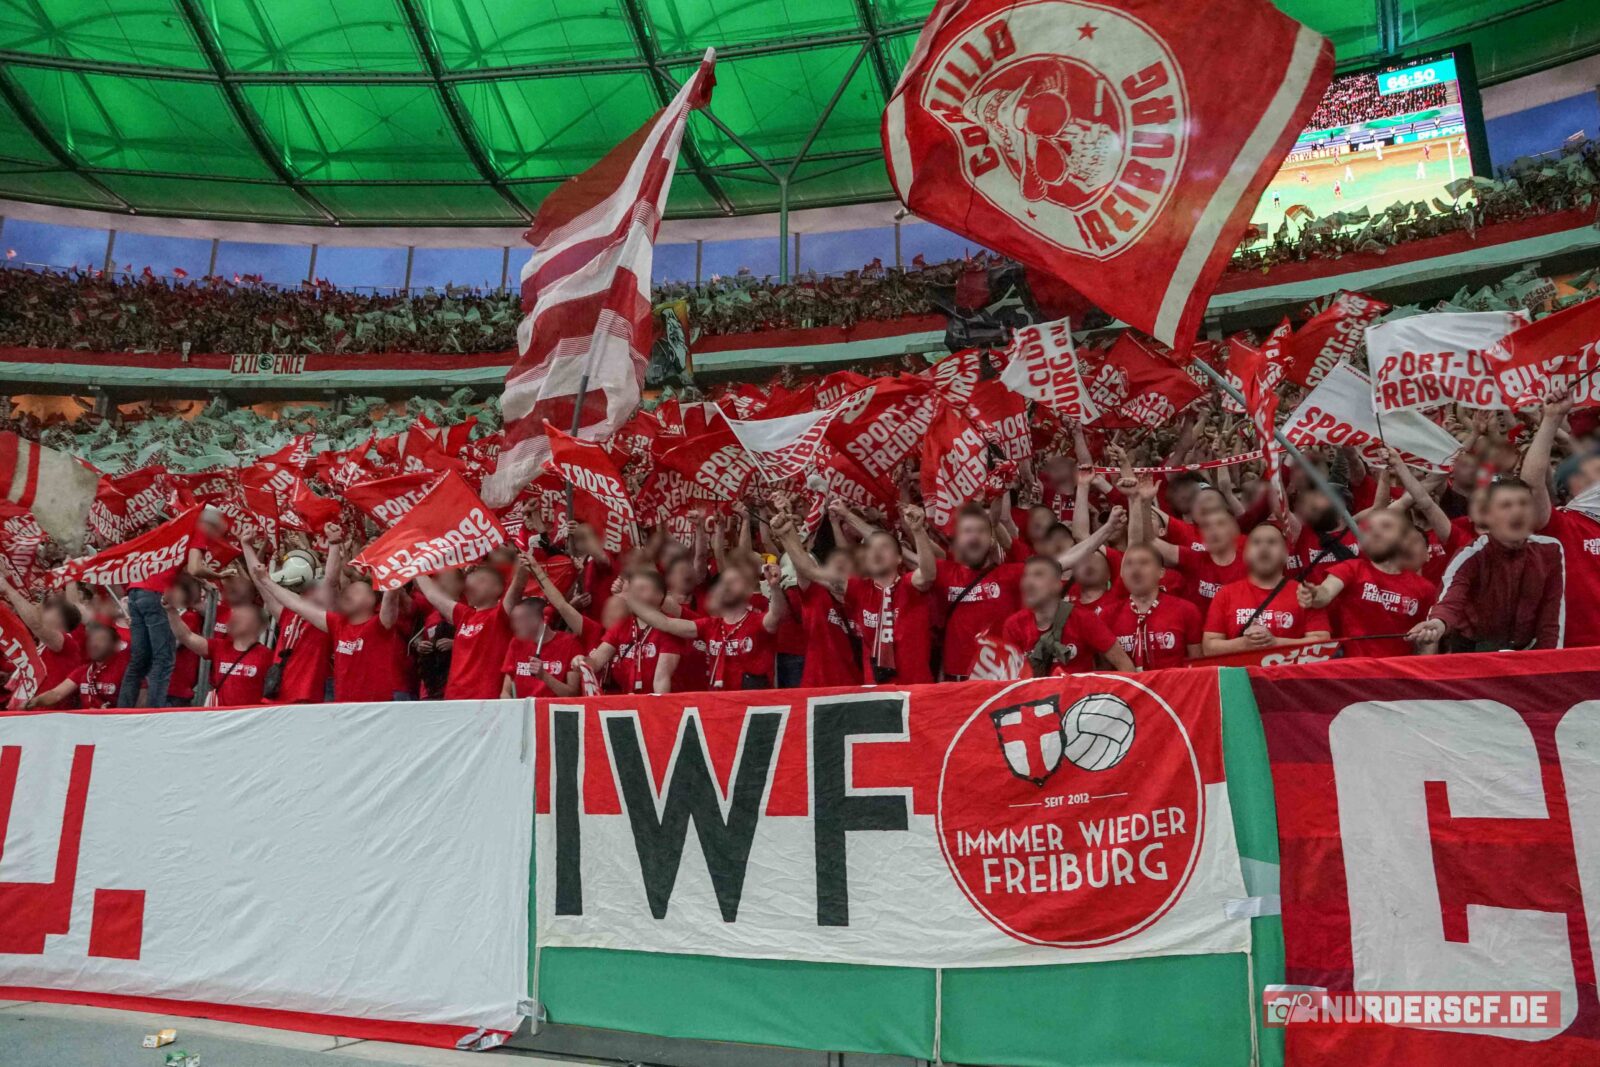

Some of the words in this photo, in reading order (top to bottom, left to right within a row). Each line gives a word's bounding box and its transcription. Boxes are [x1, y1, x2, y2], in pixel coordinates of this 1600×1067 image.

[549, 692, 914, 928] IWF
[1044, 795, 1065, 808] SEIT
[1067, 792, 1090, 805] 2012
[957, 823, 1064, 857] IMMMER
[1078, 806, 1187, 848] WIEDER
[982, 842, 1169, 894] FREIBURG
[1328, 698, 1600, 1042] C
